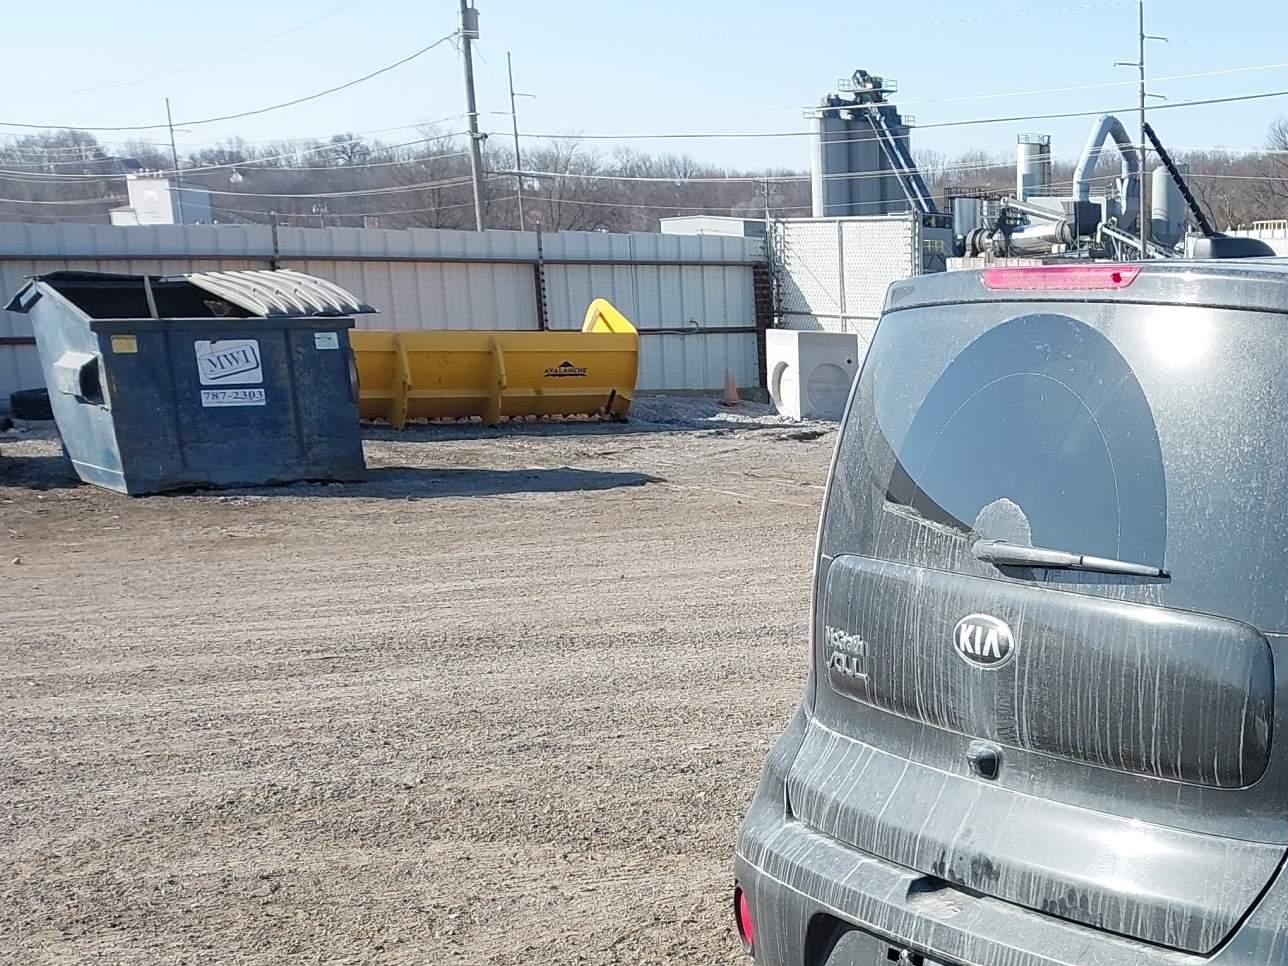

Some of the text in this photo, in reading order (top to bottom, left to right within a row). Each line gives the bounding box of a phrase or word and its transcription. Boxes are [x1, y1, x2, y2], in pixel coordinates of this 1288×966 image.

[206, 350, 251, 373] MWI
[203, 390, 263, 400] 787-2303
[960, 623, 1001, 658] KIA
